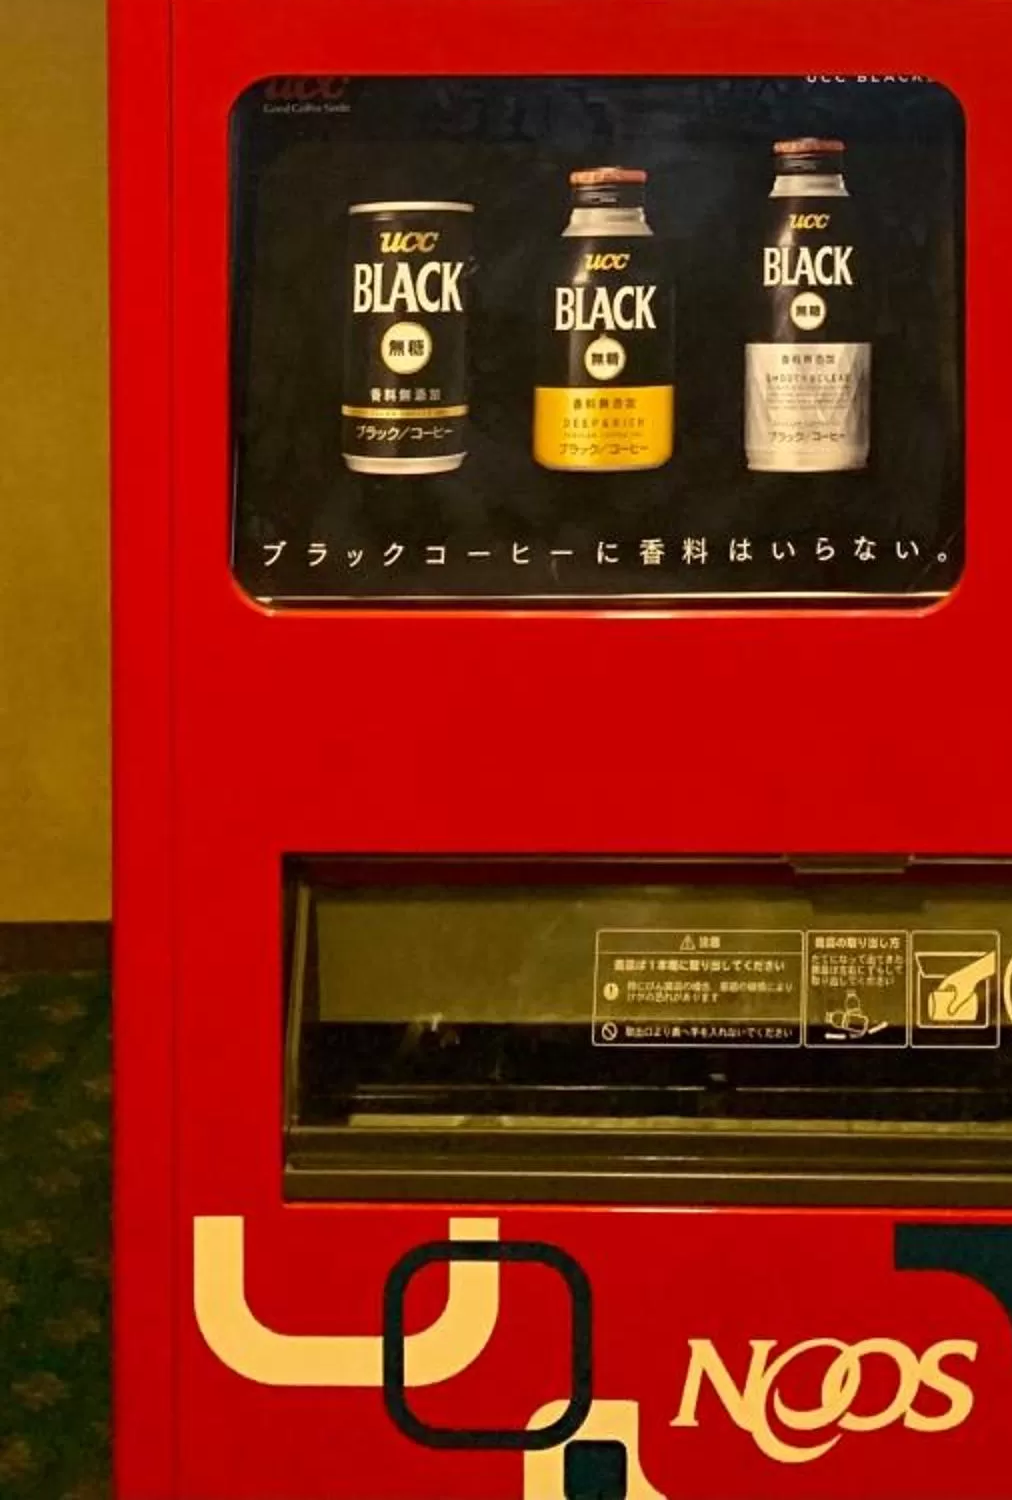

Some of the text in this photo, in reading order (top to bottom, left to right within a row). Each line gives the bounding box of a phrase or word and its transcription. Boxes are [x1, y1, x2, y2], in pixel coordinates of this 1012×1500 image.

[352, 261, 464, 313] BLACK
[762, 245, 854, 287] BLACK
[554, 285, 657, 331] BLACK
[387, 339, 425, 357] 無糖
[262, 535, 948, 568] ブラックコーヒーに香料はいらない。
